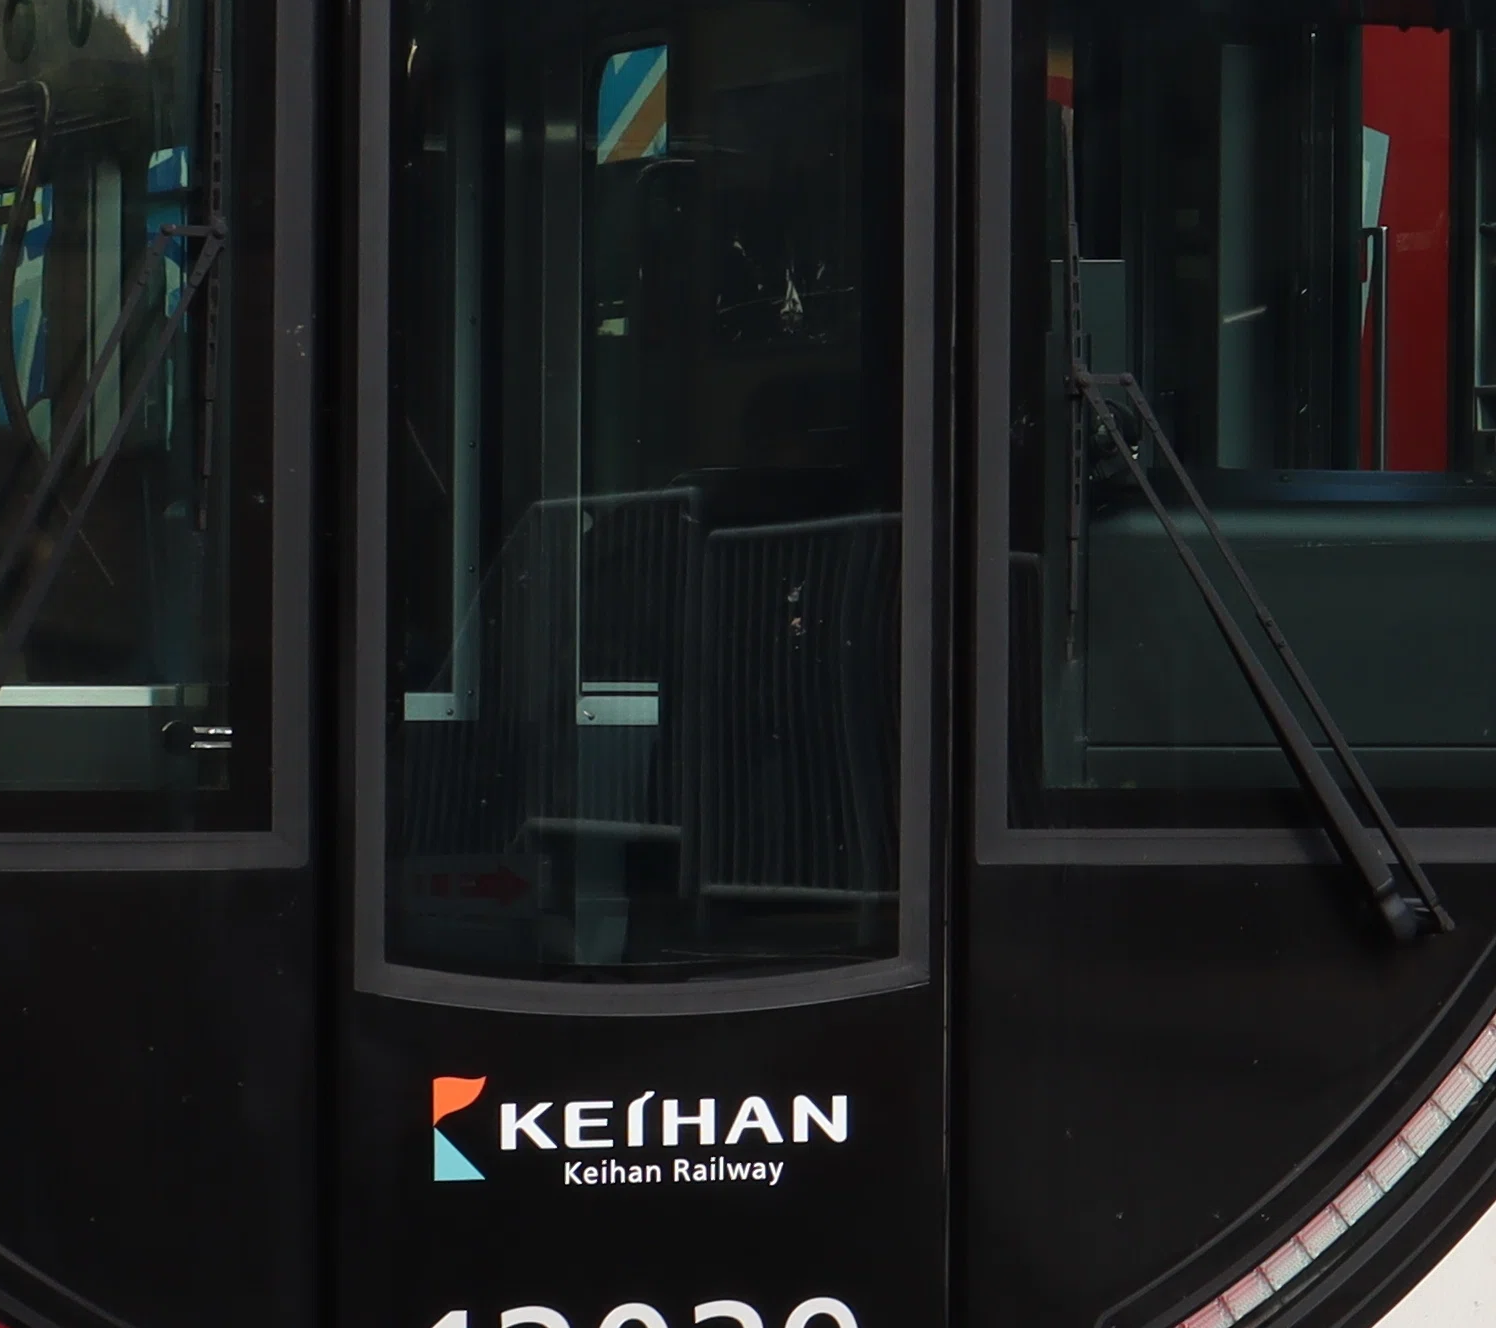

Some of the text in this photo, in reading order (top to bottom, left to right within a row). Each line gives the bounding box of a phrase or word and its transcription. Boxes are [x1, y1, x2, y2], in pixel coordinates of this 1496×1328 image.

[500, 1090, 848, 1151] KEIHAN
[564, 1157, 784, 1186] Keihan Railway
